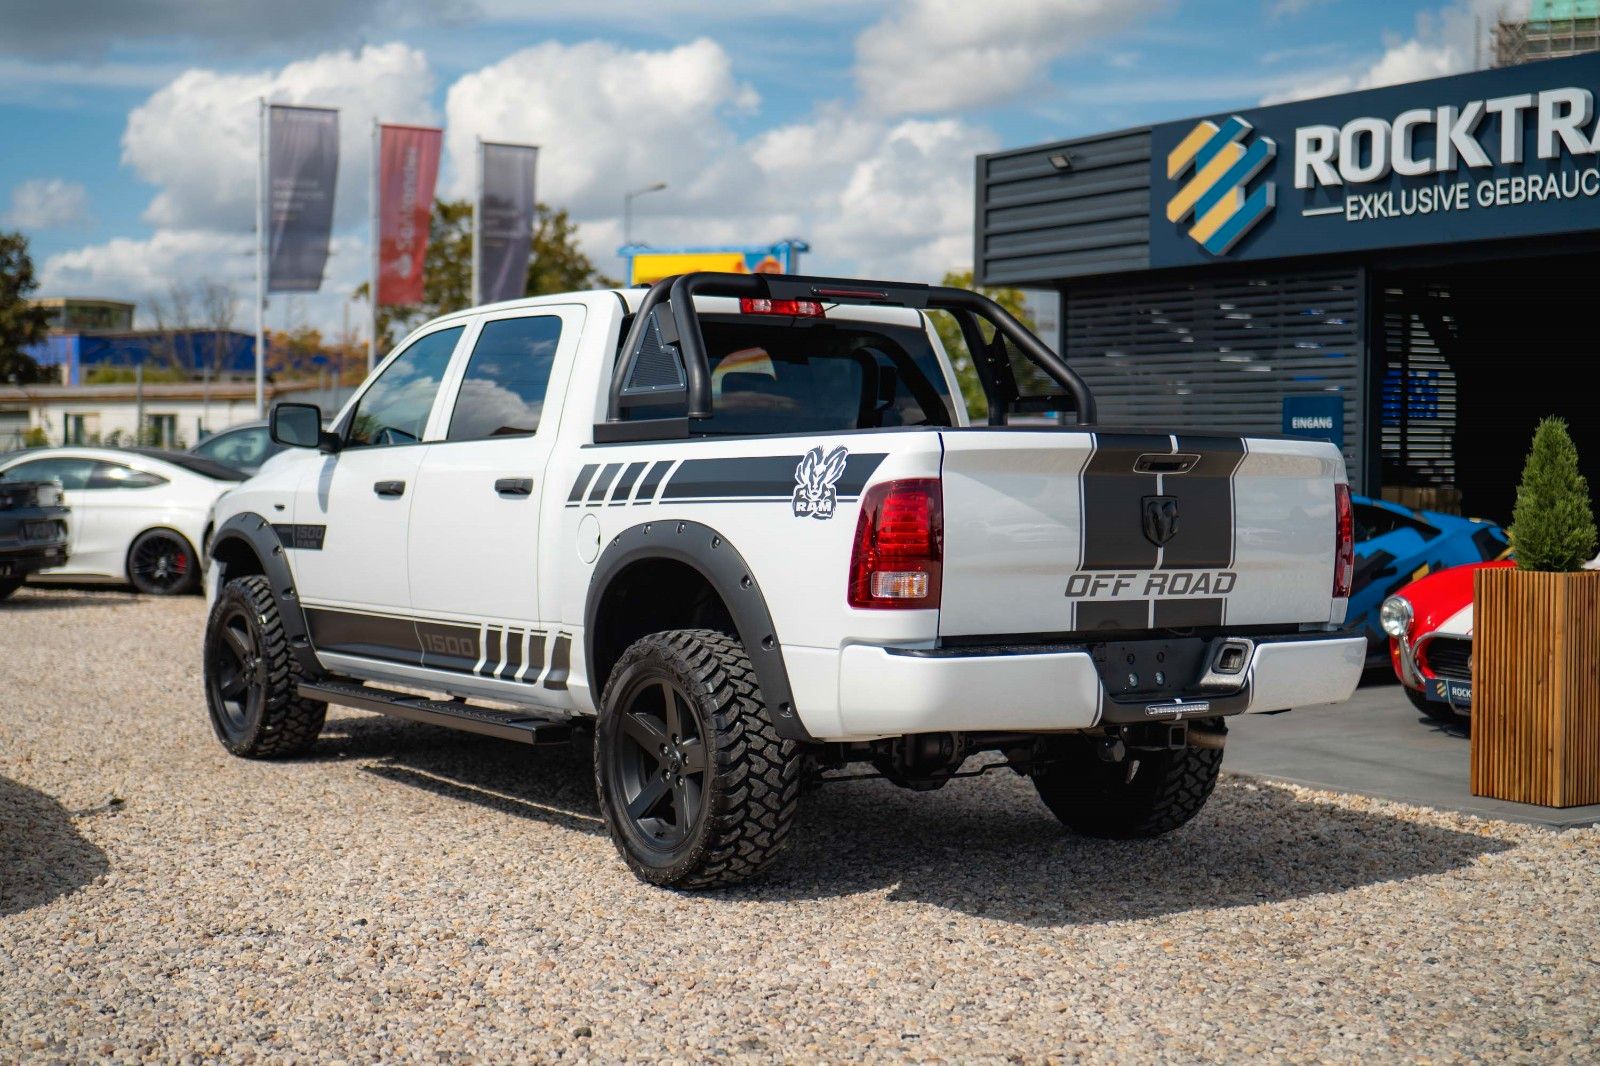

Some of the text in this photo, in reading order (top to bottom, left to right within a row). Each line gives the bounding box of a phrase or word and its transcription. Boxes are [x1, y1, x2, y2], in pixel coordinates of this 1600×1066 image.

[1346, 168, 1600, 221] EXKLUSIVE GEBRAUC
[1291, 416, 1333, 429] EINGANG
[795, 499, 832, 513] RAM
[296, 526, 323, 539] 1500
[1064, 572, 1237, 598] OFF ROAD
[423, 633, 475, 657] 1500
